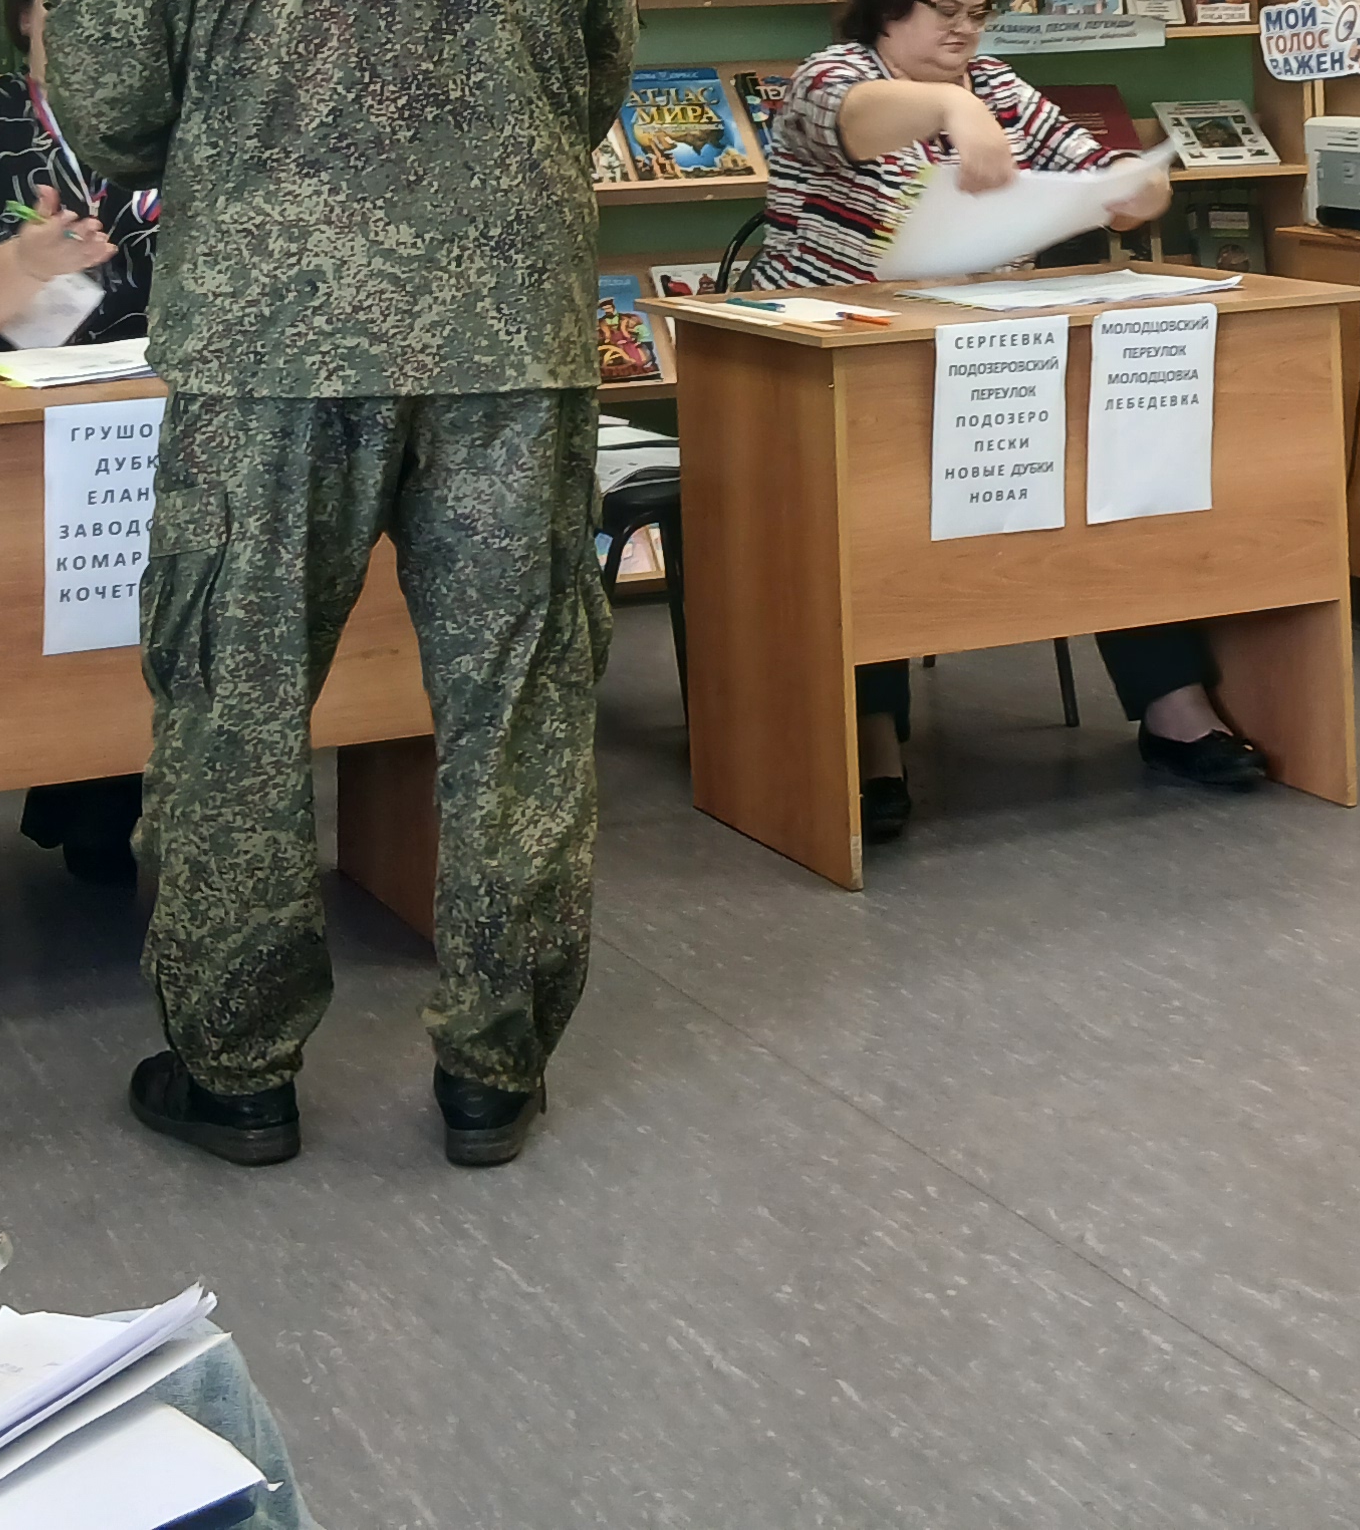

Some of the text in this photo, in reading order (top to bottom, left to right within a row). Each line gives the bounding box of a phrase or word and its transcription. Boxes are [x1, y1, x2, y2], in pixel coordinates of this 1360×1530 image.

[1265, 0, 1317, 32] МОЙ
[1266, 28, 1329, 55] ГОЛОС
[626, 87, 719, 107] АТЛАС
[636, 104, 722, 125] МИРА
[1101, 316, 1209, 335] МОЛОДЦОВСКИЙ
[954, 331, 1055, 350] СЕРГЕЕВКА
[1123, 344, 1187, 359] ПЕРЕУЛОК
[948, 356, 1059, 378] ПОДОЗЕРОВСКИЙ
[1107, 369, 1199, 385] МОЛОДЦОВКА
[970, 385, 1036, 402] ПЕРЕУЛОК
[1105, 393, 1200, 411] ЛЕБЕДЕВКА
[956, 409, 1049, 429] ПОДОЗЕРО
[71, 423, 153, 442] ГРУШО
[974, 437, 1030, 452] ПЕСКИ
[95, 455, 159, 476] ДУБК
[945, 461, 1054, 481] НОВЫЕ ДУБКИ
[87, 487, 150, 506] ЕЛАН
[969, 488, 1028, 504] НОВАЯ
[59, 519, 154, 540] ЗАВОДО
[56, 551, 143, 572] КОМАР
[59, 582, 137, 603] КОЧЕТ
